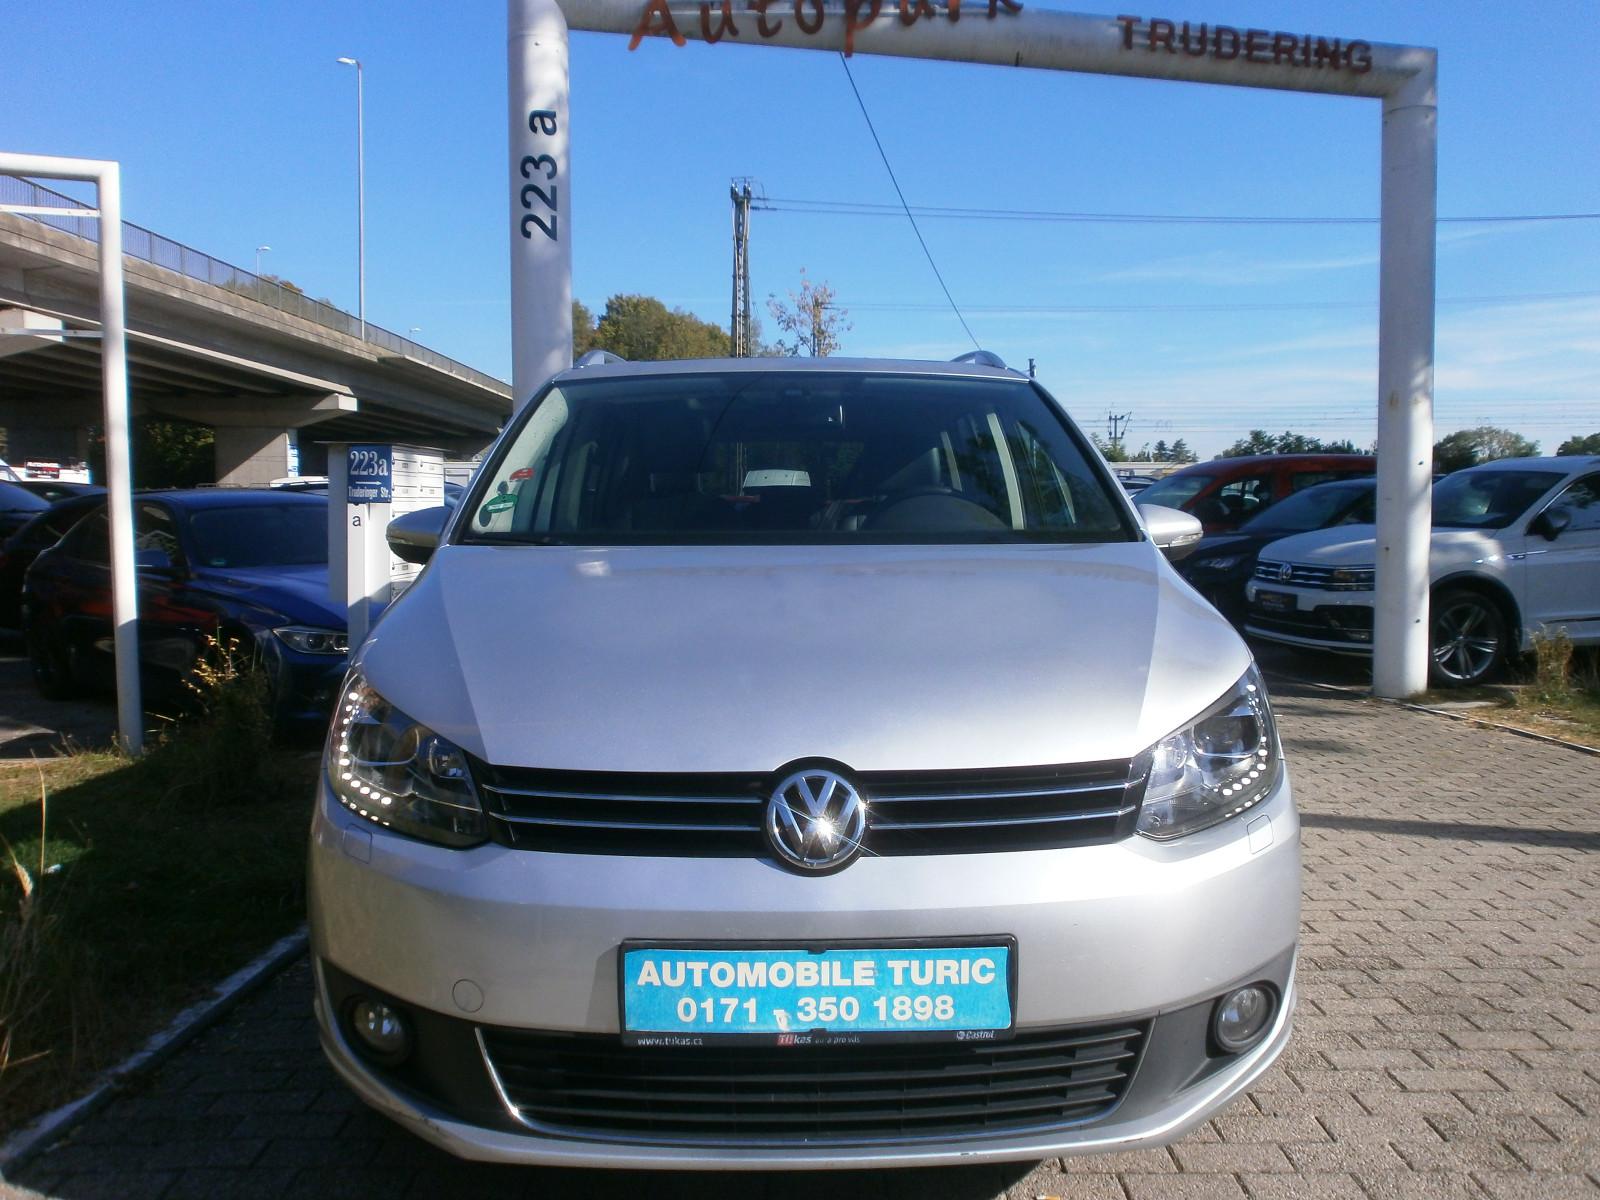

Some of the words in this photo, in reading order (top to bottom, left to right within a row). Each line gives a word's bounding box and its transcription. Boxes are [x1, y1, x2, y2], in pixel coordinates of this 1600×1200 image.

[1117, 14, 1372, 74] TRUDERING
[528, 109, 557, 136] a
[520, 154, 558, 242] 223
[350, 451, 388, 476] 223a
[352, 515, 361, 527] a
[637, 961, 875, 988] AUTOMOBILE
[887, 958, 996, 985] TURIC
[676, 998, 758, 1023] 0171
[797, 996, 860, 1022] 350
[873, 996, 955, 1021] 1898
